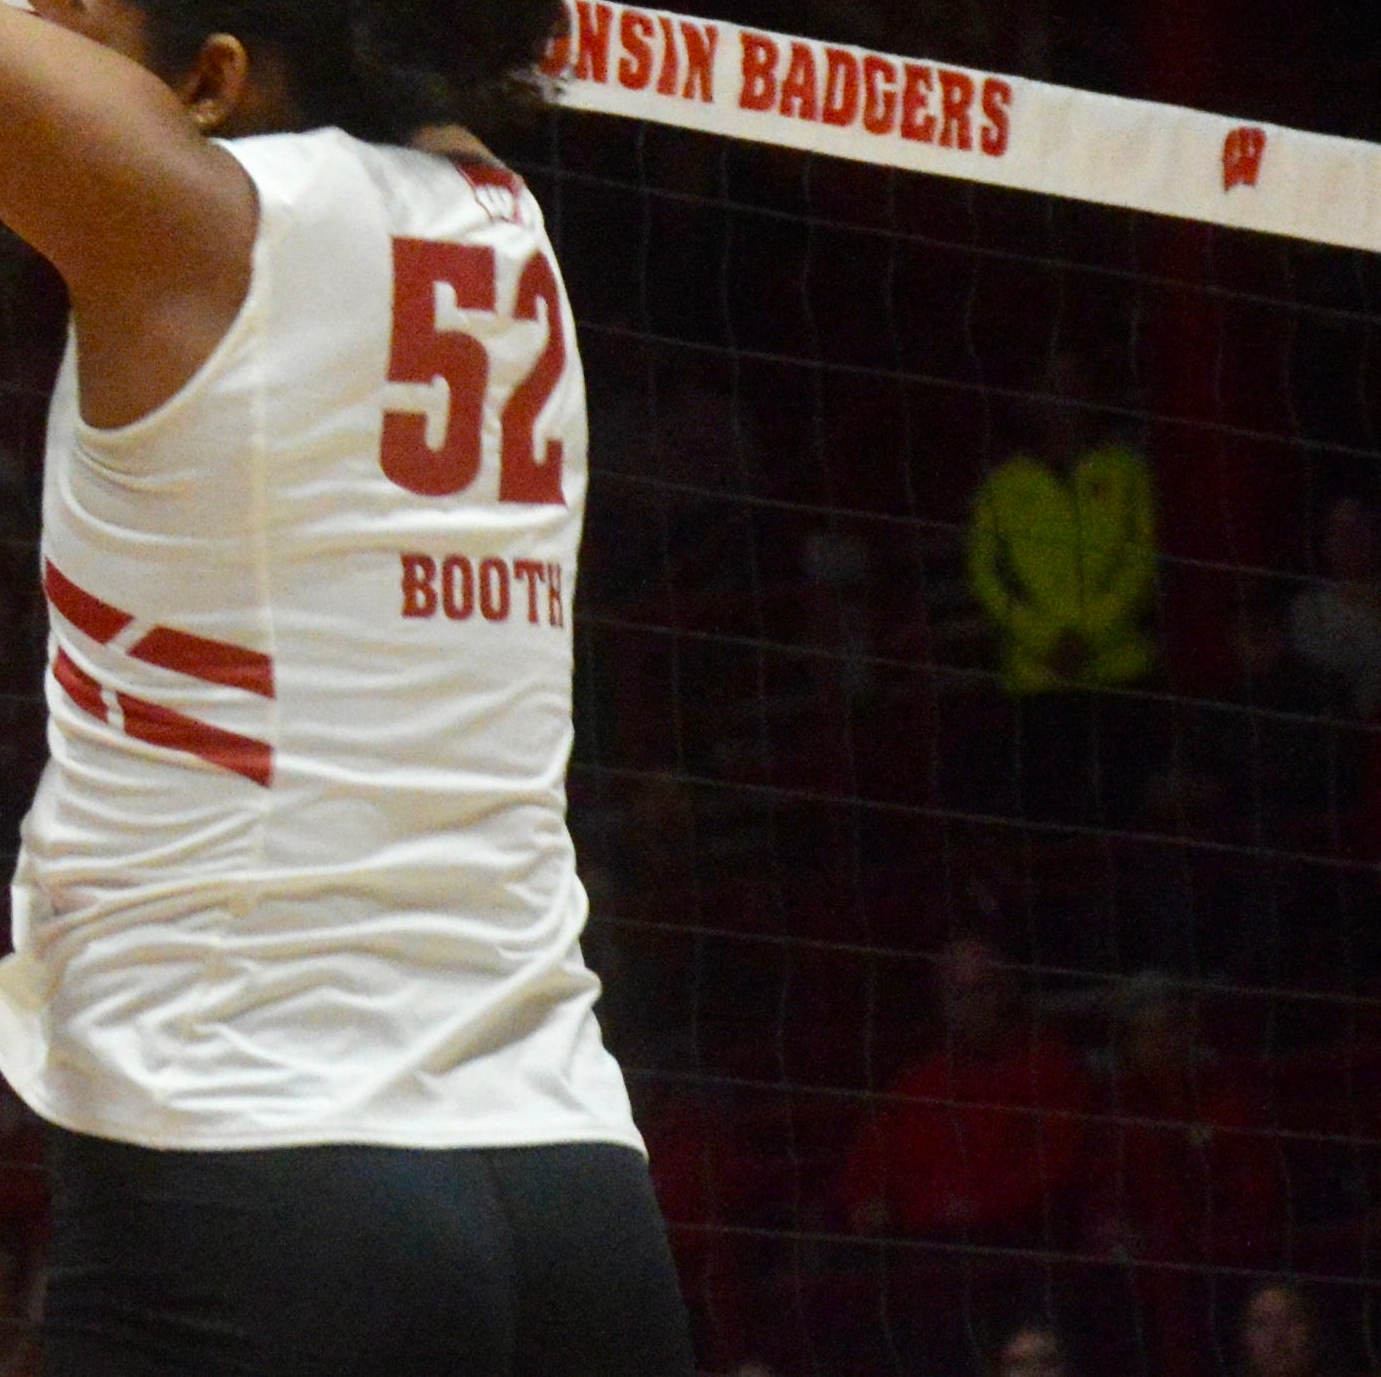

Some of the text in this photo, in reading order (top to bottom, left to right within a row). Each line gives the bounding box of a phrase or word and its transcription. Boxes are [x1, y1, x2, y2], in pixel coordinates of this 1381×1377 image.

[738, 31, 1012, 158] BADGERS
[379, 234, 568, 505] 52
[401, 552, 564, 628] BOOTH
